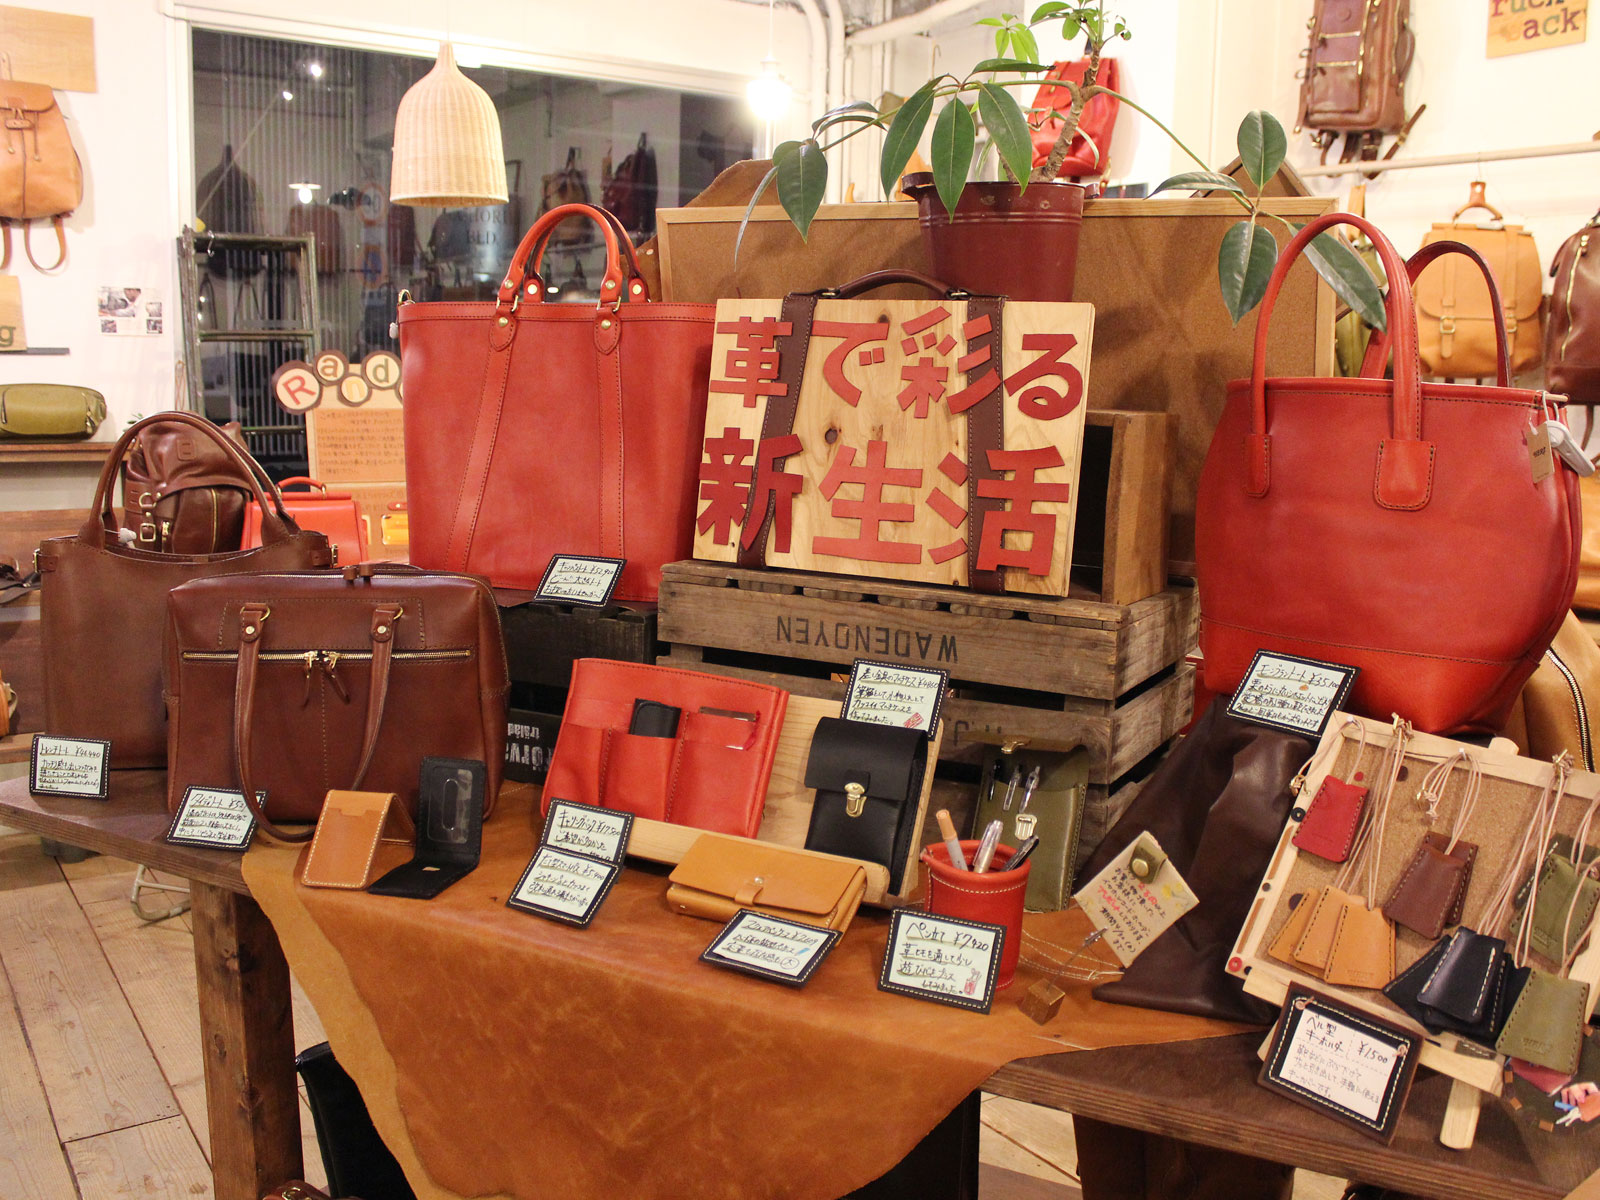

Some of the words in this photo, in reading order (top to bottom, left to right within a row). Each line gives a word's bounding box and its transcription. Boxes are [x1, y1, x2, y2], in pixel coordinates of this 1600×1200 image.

[710, 306, 1083, 420] 革で彩る
[697, 427, 1069, 577] 新生活
[905, 922, 946, 943] ペン立て
[1306, 1014, 1337, 1037] ベル型
